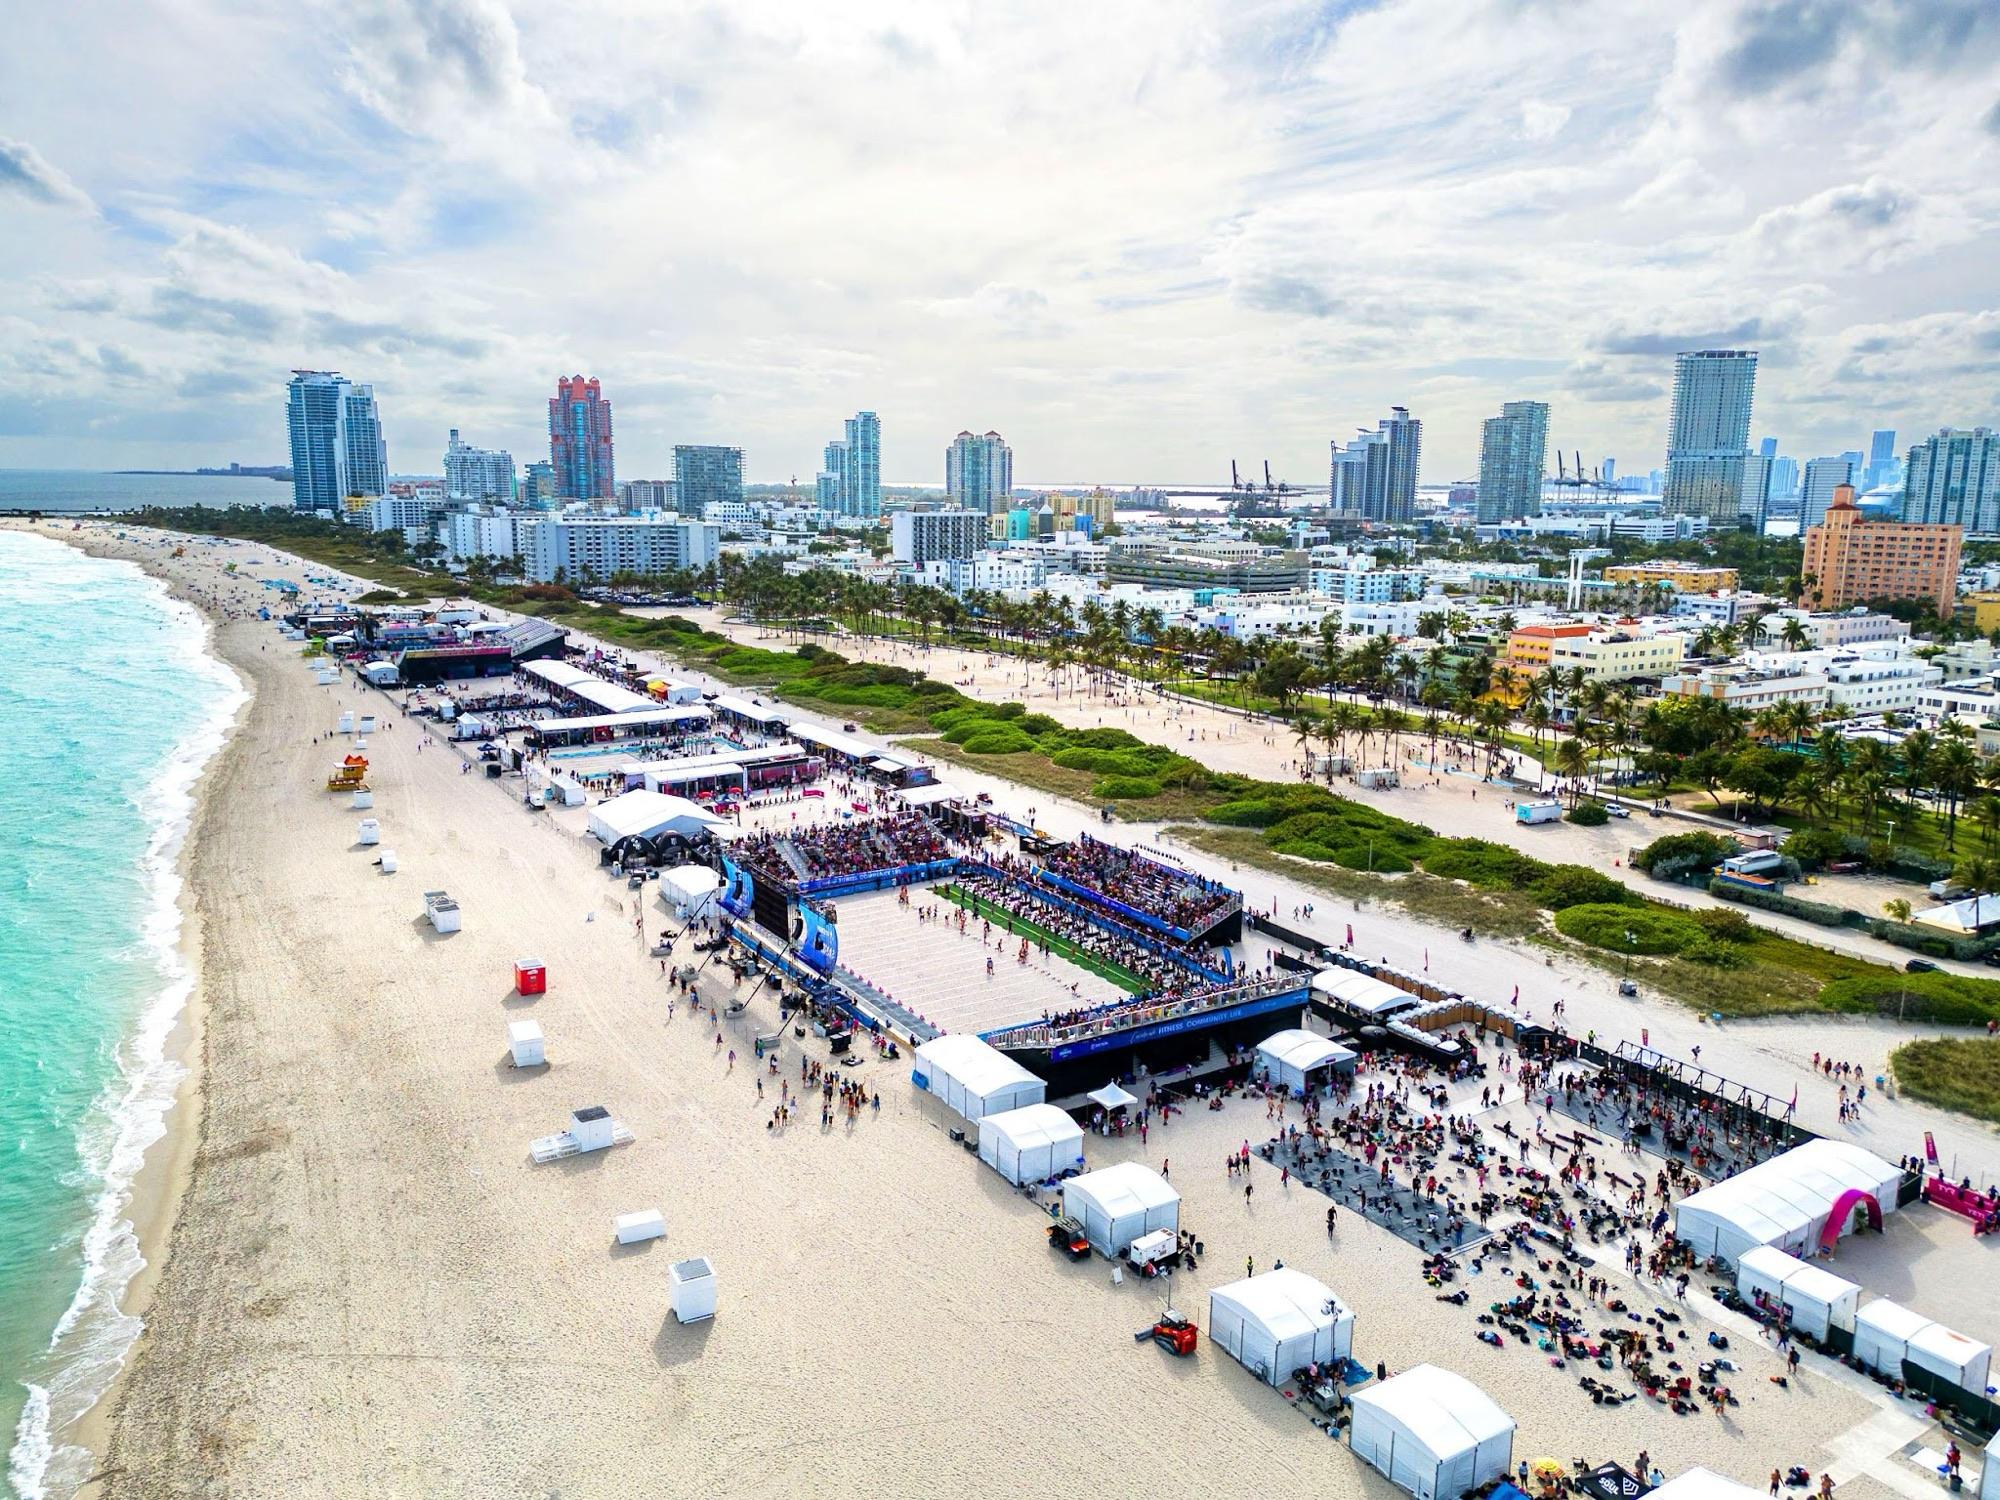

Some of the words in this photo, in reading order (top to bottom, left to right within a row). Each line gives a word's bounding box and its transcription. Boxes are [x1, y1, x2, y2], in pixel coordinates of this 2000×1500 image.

[1158, 1022, 1184, 1034] FITNESS
[1187, 1013, 1227, 1028] COMMUNITY
[1938, 1184, 1956, 1195] TYR
[1968, 1209, 1985, 1218] YETI
[1598, 1477, 1619, 1495] SOUL
